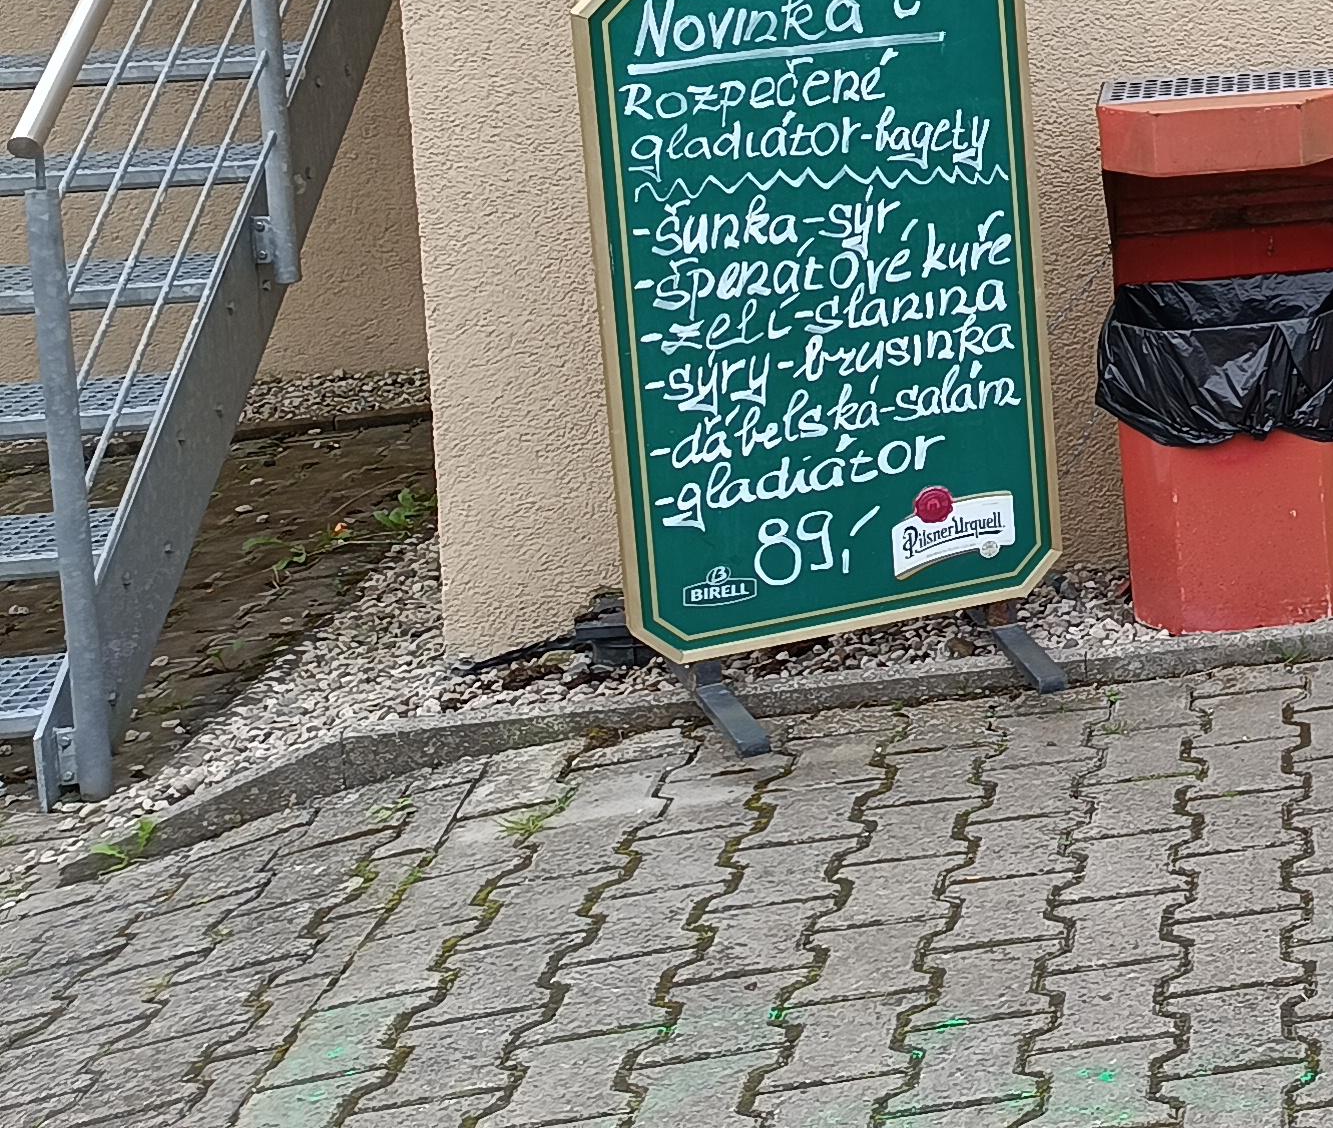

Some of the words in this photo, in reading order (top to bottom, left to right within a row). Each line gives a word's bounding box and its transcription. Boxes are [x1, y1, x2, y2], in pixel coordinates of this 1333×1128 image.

[618, 47, 900, 127] Rozpečené
[922, 210, 1014, 278] kuře
[902, 522, 955, 560] Pilsner
[951, 511, 1002, 539] Urquell
[690, 582, 750, 602] BIRELL
